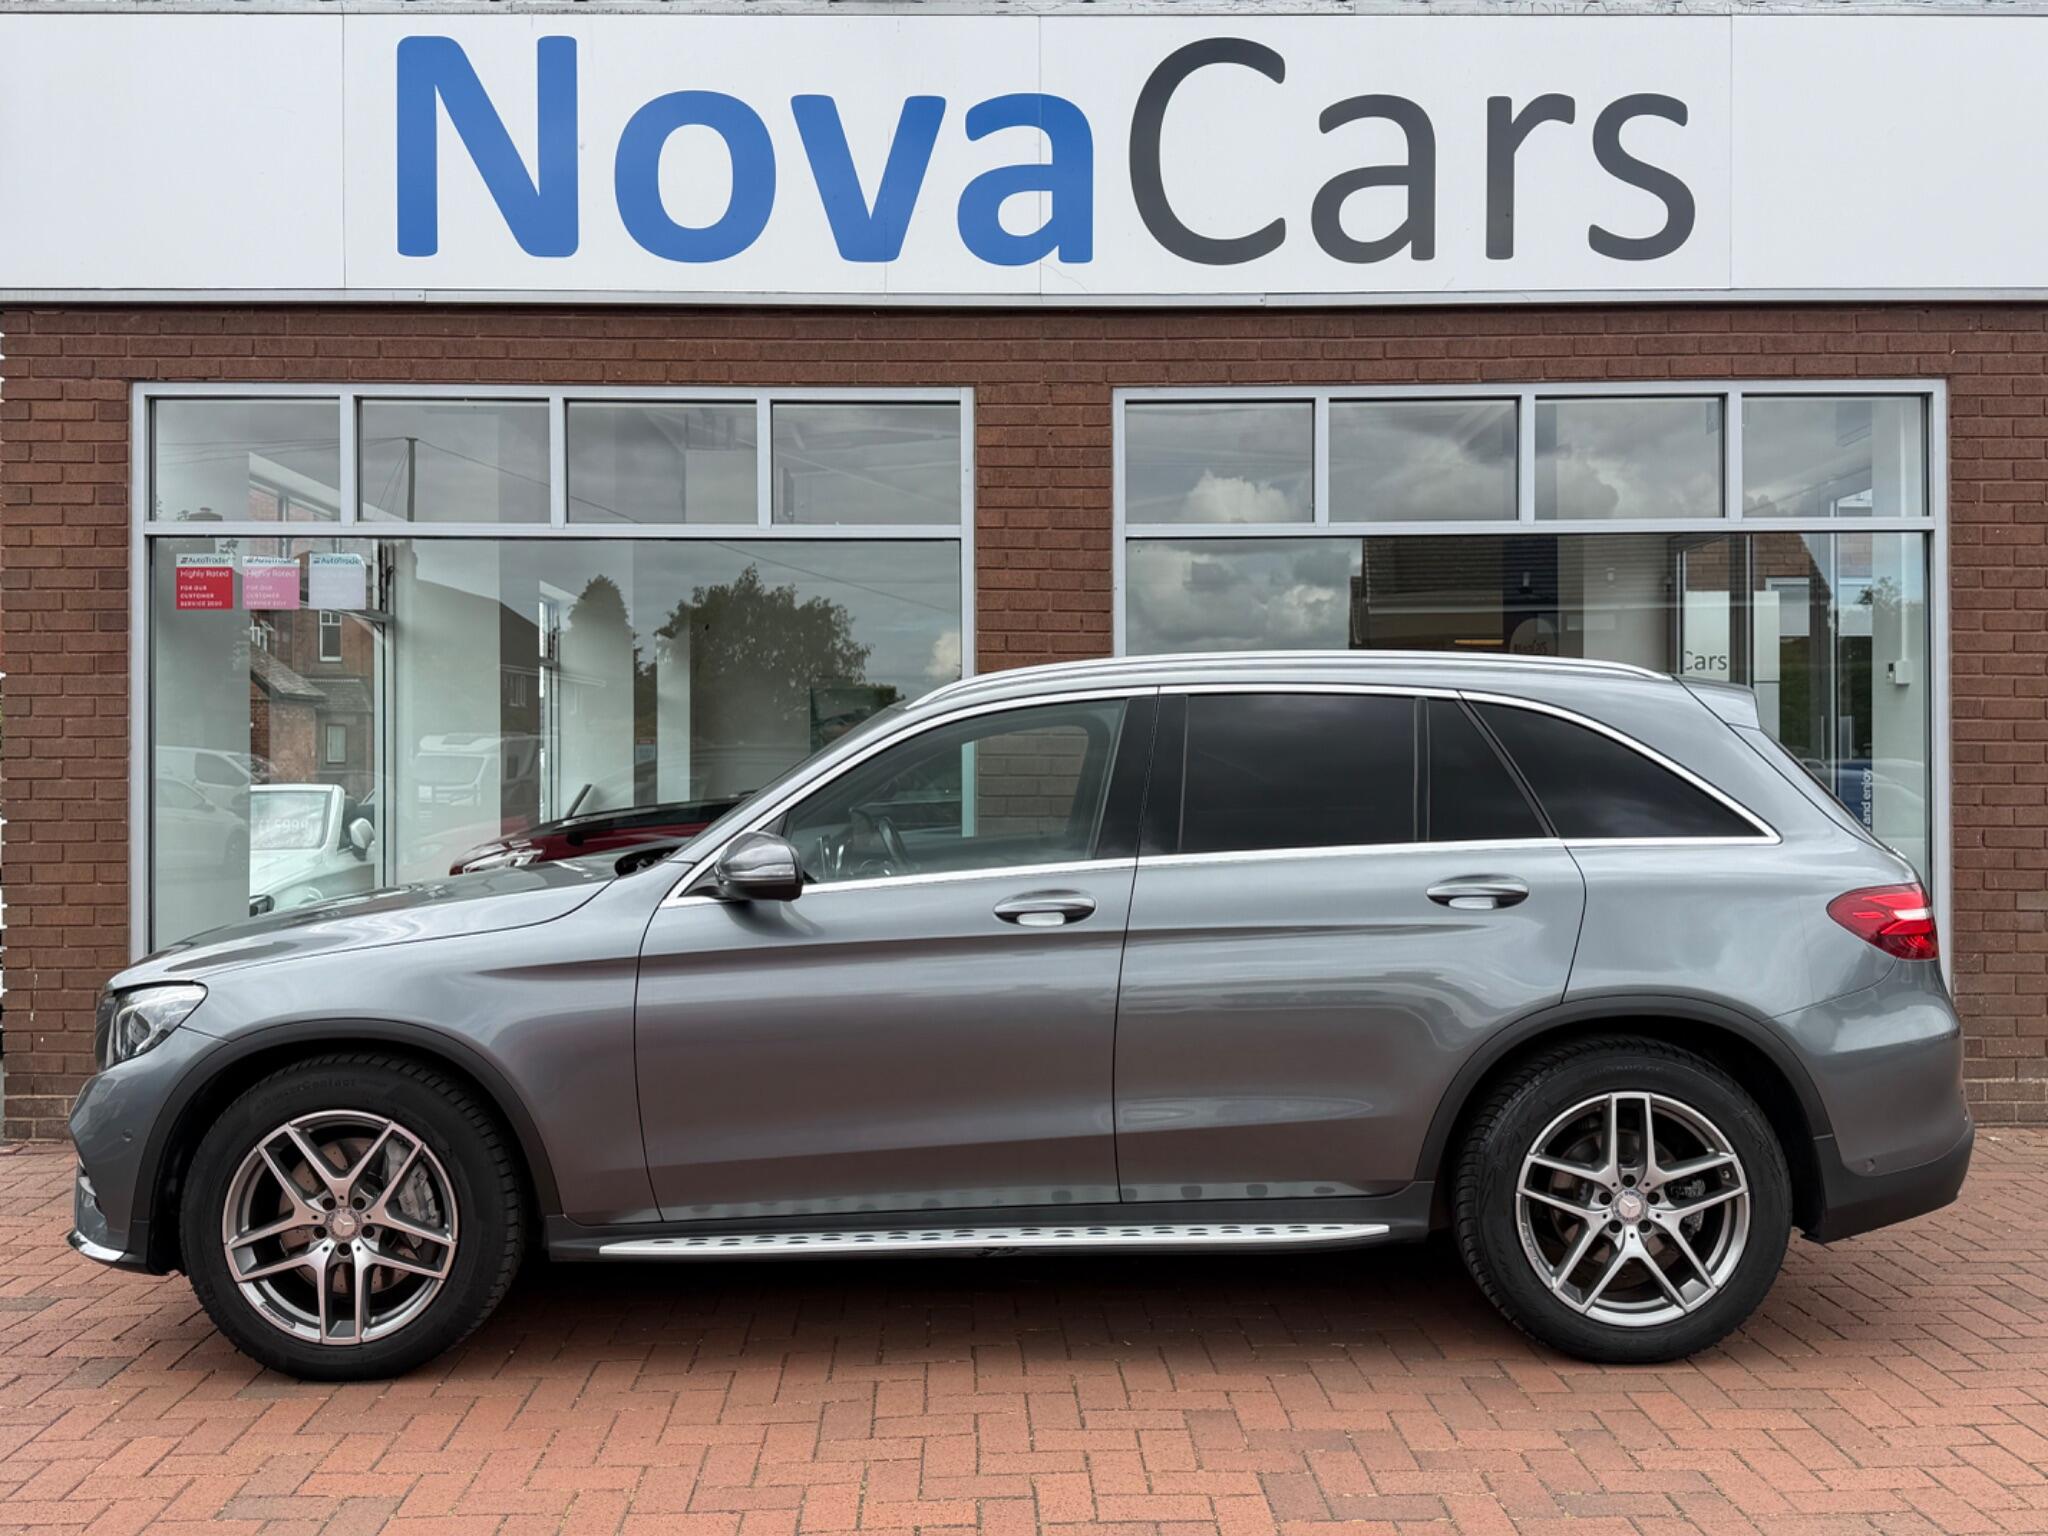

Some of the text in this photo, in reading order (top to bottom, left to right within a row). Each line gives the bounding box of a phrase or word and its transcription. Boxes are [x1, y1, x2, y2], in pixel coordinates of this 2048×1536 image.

[396, 36, 1696, 265] NovaCars
[180, 569, 229, 578] Highly Rated
[1860, 767, 1873, 800] enjoy
[1861, 801, 1872, 825] and
